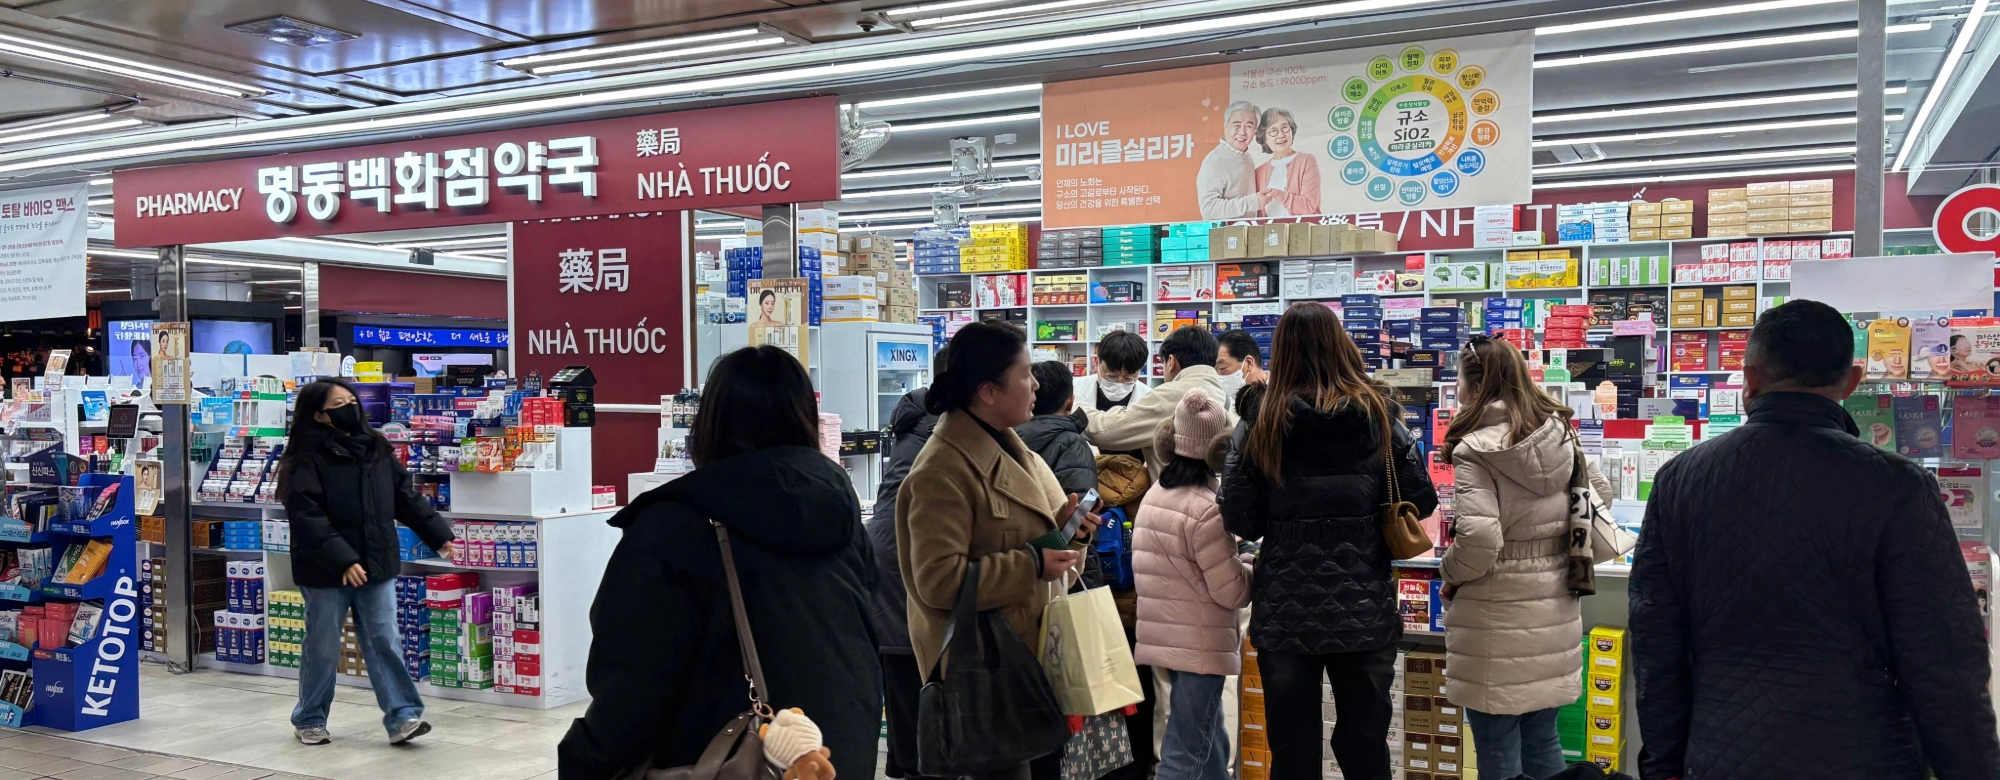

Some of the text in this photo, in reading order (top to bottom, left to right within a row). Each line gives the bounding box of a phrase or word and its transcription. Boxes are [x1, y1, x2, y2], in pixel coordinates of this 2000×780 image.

[1242, 65, 1306, 78] 식물성 규소 100%
[1242, 81, 1257, 90] 규소
[1260, 79, 1275, 88] 농도
[1473, 97, 1493, 105] 면역력
[1397, 109, 1429, 125] 규소
[1056, 120, 1110, 138] I LOVE
[1393, 127, 1430, 141] SiO2
[636, 127, 682, 158] 藥局
[1055, 133, 1194, 167] 미라클실리카
[257, 136, 599, 224] 명동백화점약국
[637, 151, 791, 200] NHÀ THUỐC
[1056, 177, 1102, 188] 인체의 노화는
[1056, 185, 1151, 199] 규소의 고갈로부터 시작된다.
[1, 203, 21, 218] 토탈
[23, 199, 53, 217] 바이오
[136, 188, 244, 218] PHARMACY
[1056, 200, 1078, 210] 당신의
[1079, 199, 1102, 208] 건강을
[1104, 198, 1119, 207] 위한
[1145, 195, 1161, 204] 선택
[558, 248, 630, 294] 藥局
[366, 330, 374, 338] 더
[378, 328, 392, 342] 쉽고
[397, 330, 438, 344] 편안한,
[451, 332, 461, 341] 더
[469, 331, 491, 344] 새로운
[528, 316, 667, 355] NHÀ THUỐC
[890, 349, 918, 362] XINGX
[31, 465, 55, 477] 신신파스
[81, 579, 138, 717] KETOTOP
